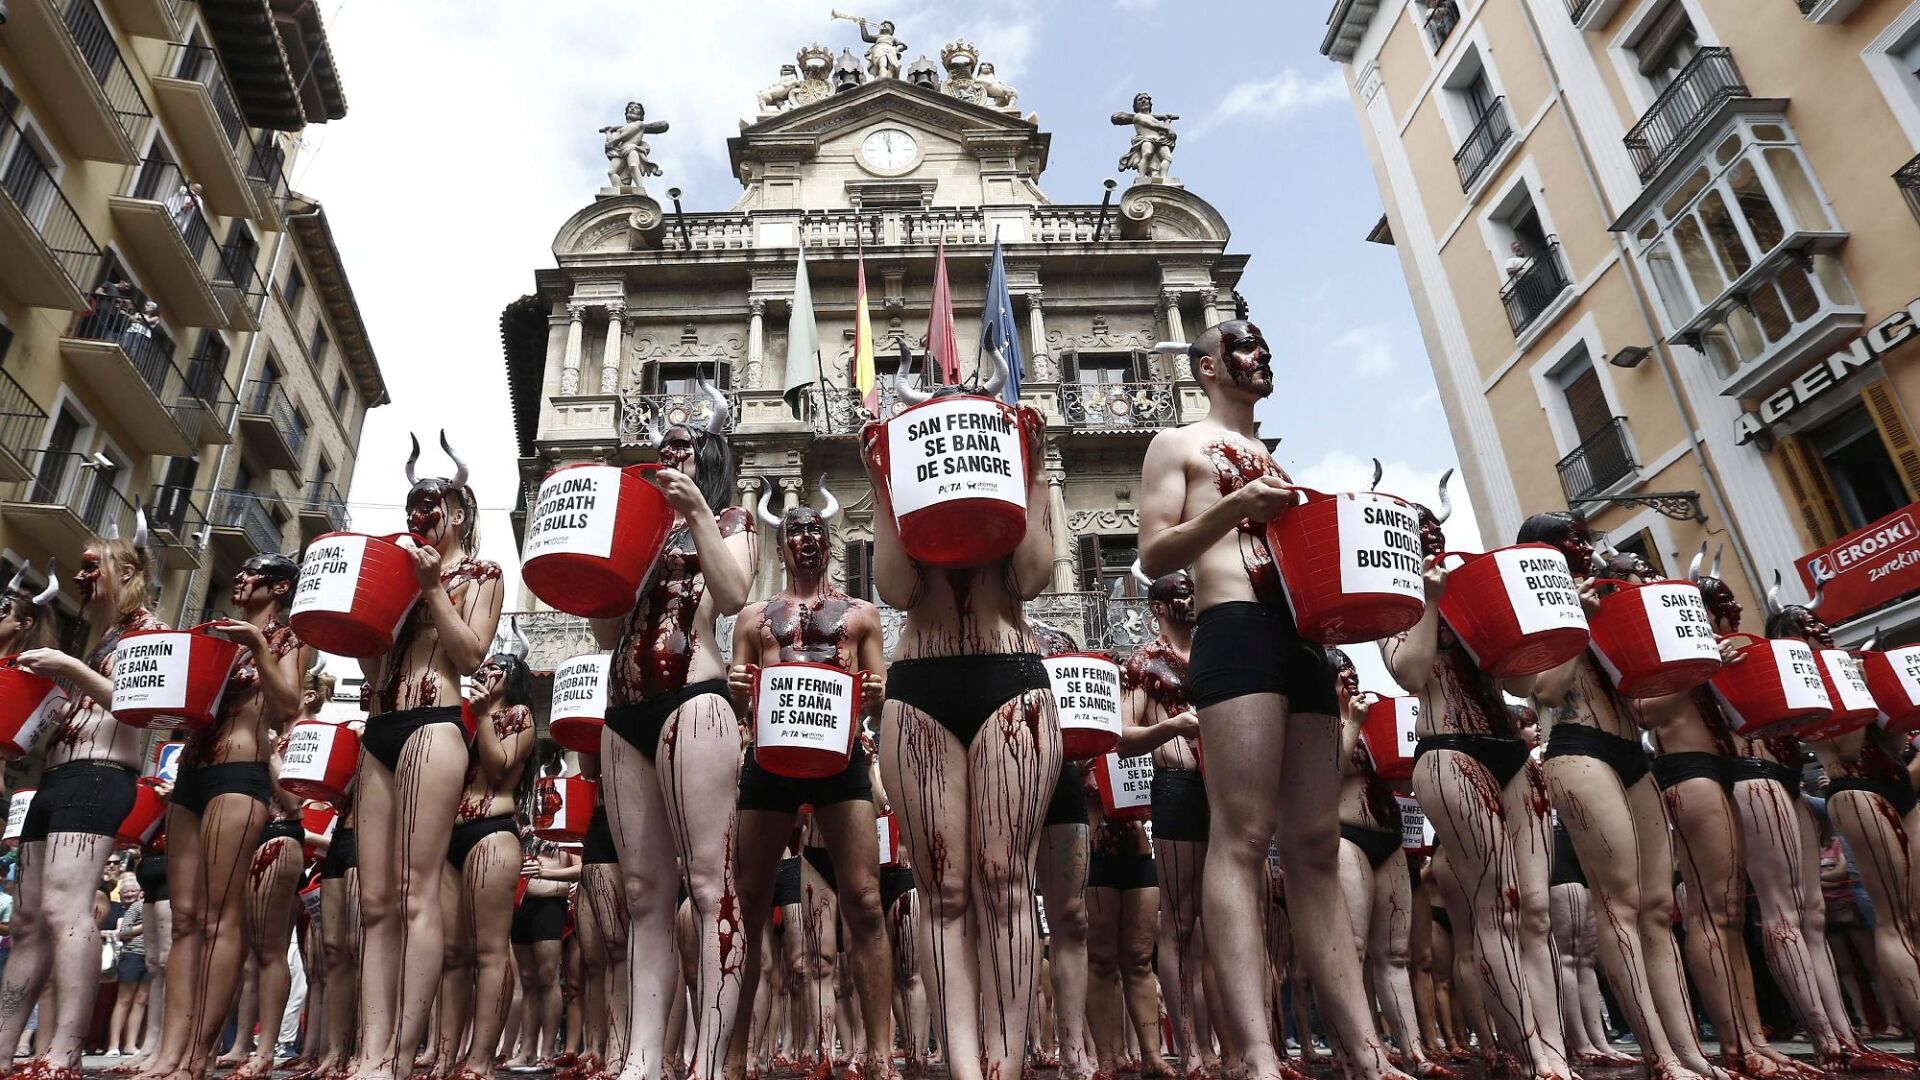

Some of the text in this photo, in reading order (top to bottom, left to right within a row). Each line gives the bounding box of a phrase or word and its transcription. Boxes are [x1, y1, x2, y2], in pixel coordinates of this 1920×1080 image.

[908, 412, 1011, 442] SAN FERMÍN
[924, 430, 1001, 457] SE BAÑA
[916, 455, 1012, 482] DE SANGRE
[538, 478, 598, 504] MPLONA:
[543, 513, 588, 532] BULLS
[1837, 521, 1912, 567] EROSKI
[321, 558, 348, 573] FÜR
[1536, 591, 1565, 606] FOR
[1661, 594, 1687, 607] SAN
[1679, 609, 1695, 622] SE
[1675, 625, 1694, 638] DE
[129, 640, 173, 658] FERMÍN
[118, 657, 158, 676] SE BAÑA
[1055, 667, 1079, 679] SAN
[1792, 663, 1805, 674] ET
[120, 674, 165, 691] SANGRE
[770, 677, 843, 697] SAN FERMÍN
[1067, 681, 1112, 698] SE BAÑA
[563, 688, 593, 702] BULLS
[778, 693, 832, 711] SE BAÑA
[1060, 696, 1116, 714] DE SANGRE
[770, 710, 838, 729] DE SANGRE
[1118, 758, 1137, 770] SAN
[1127, 770, 1140, 780] SE
[1123, 782, 1136, 792] DE
